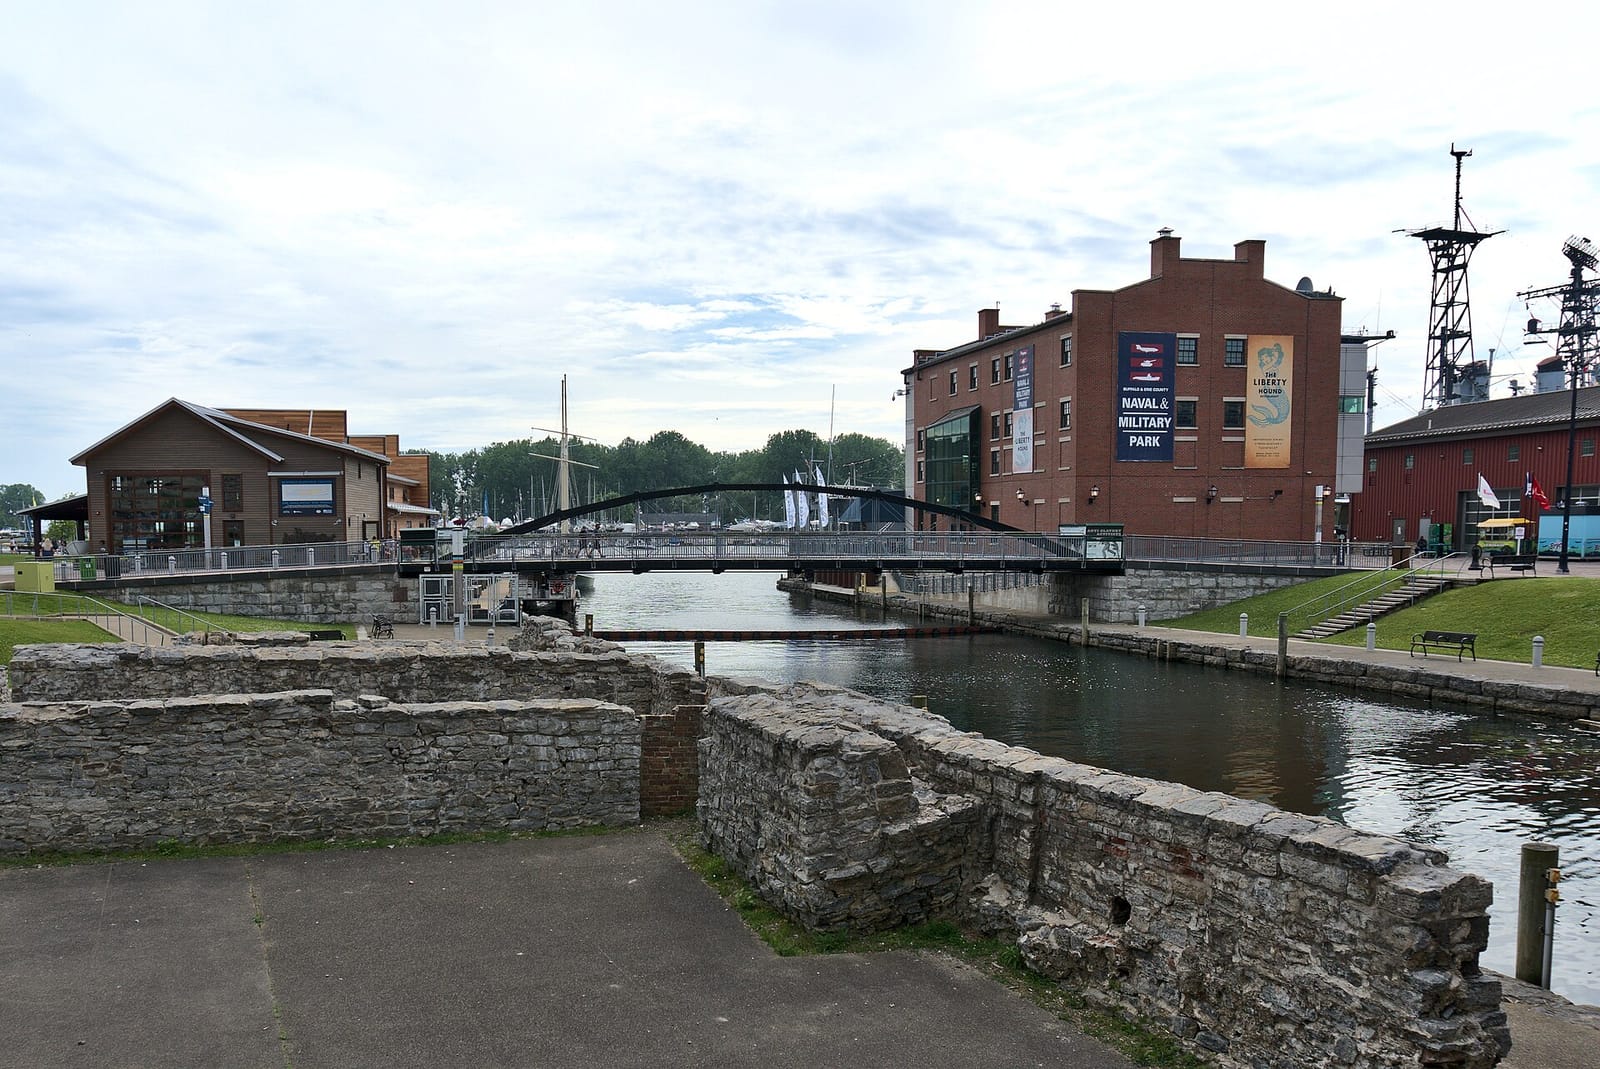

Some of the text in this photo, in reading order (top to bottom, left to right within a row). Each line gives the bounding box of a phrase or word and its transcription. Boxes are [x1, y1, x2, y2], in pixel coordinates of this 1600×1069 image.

[1122, 398, 1169, 410] NAVAL &
[1118, 416, 1172, 428] MILITARY
[1129, 436, 1160, 446] PARK
